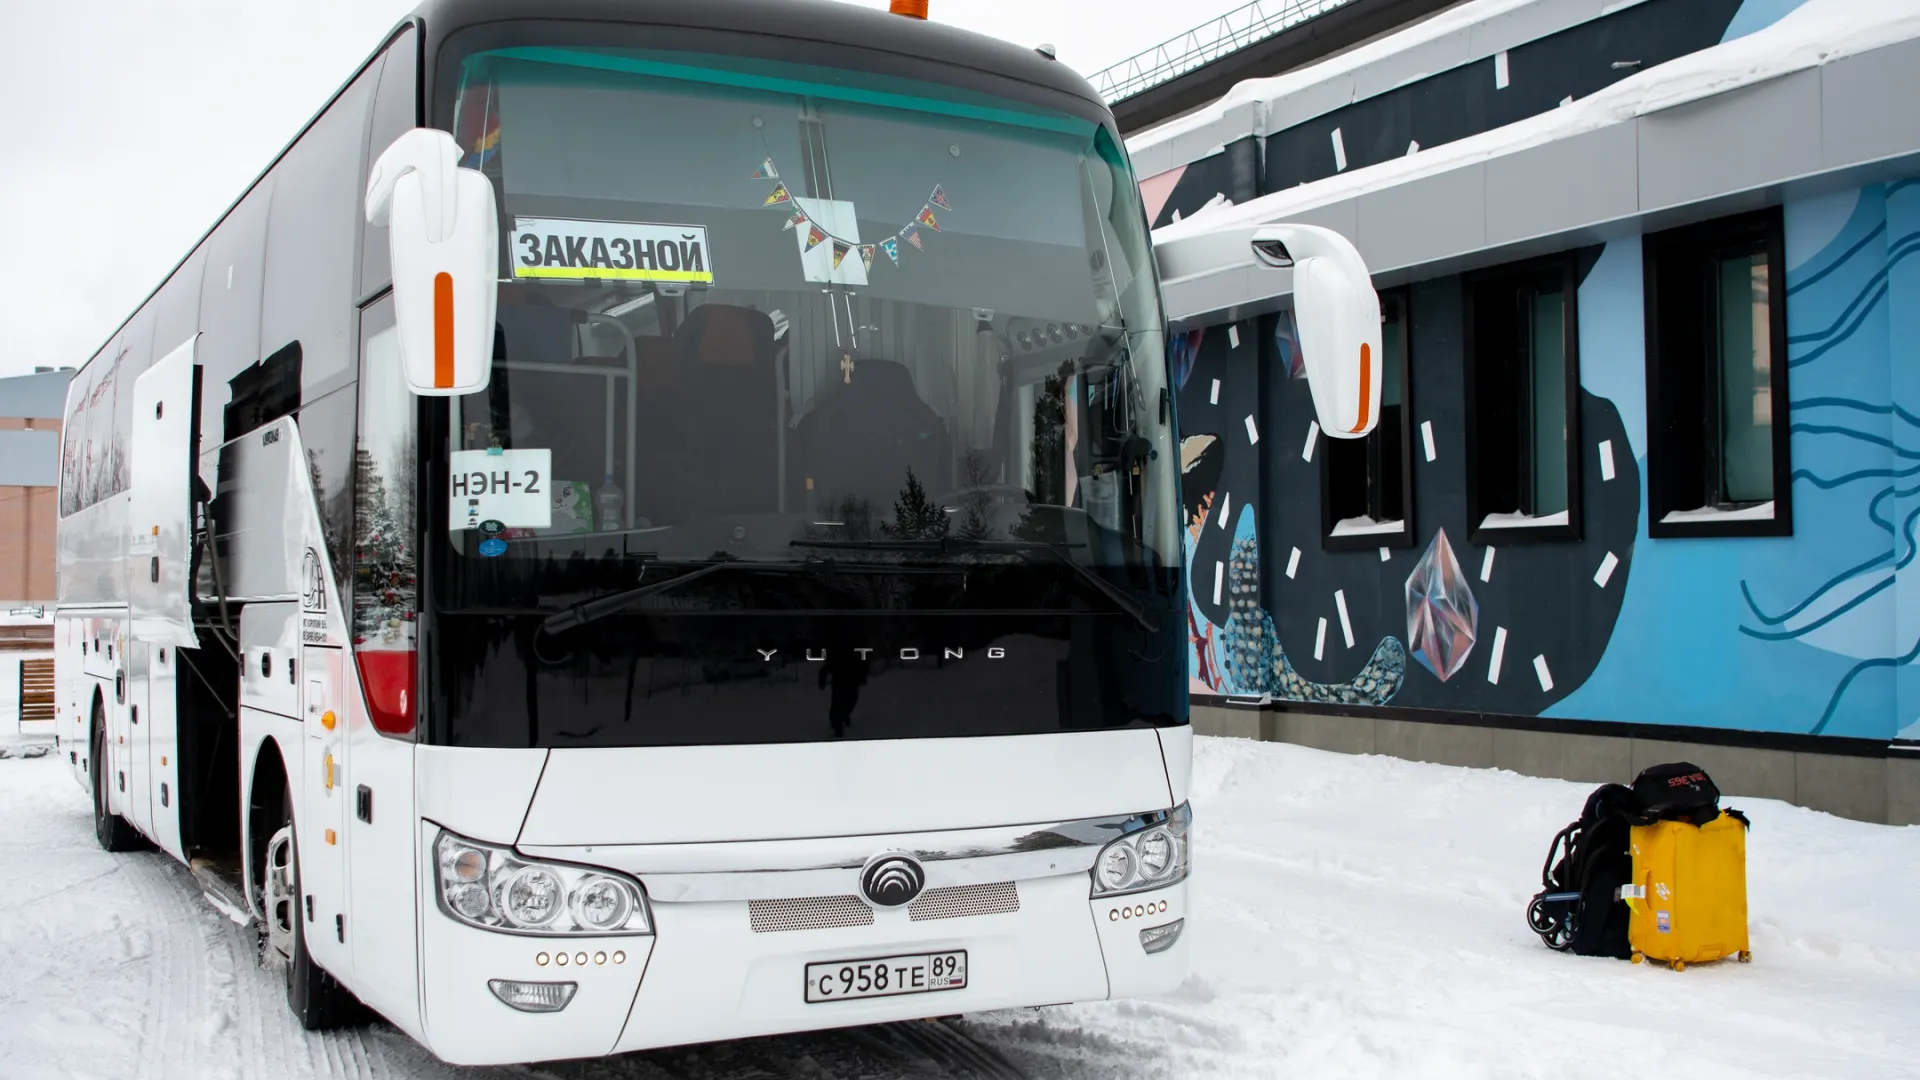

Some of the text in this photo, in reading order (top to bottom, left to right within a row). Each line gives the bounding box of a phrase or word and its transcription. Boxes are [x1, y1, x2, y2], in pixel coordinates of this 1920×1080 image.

[519, 233, 704, 272] ЗАКАЗНОЙ
[452, 470, 541, 497] НЭН-2
[757, 647, 1005, 661] YUTONG
[932, 955, 956, 977] 89
[930, 977, 949, 986] RUS
